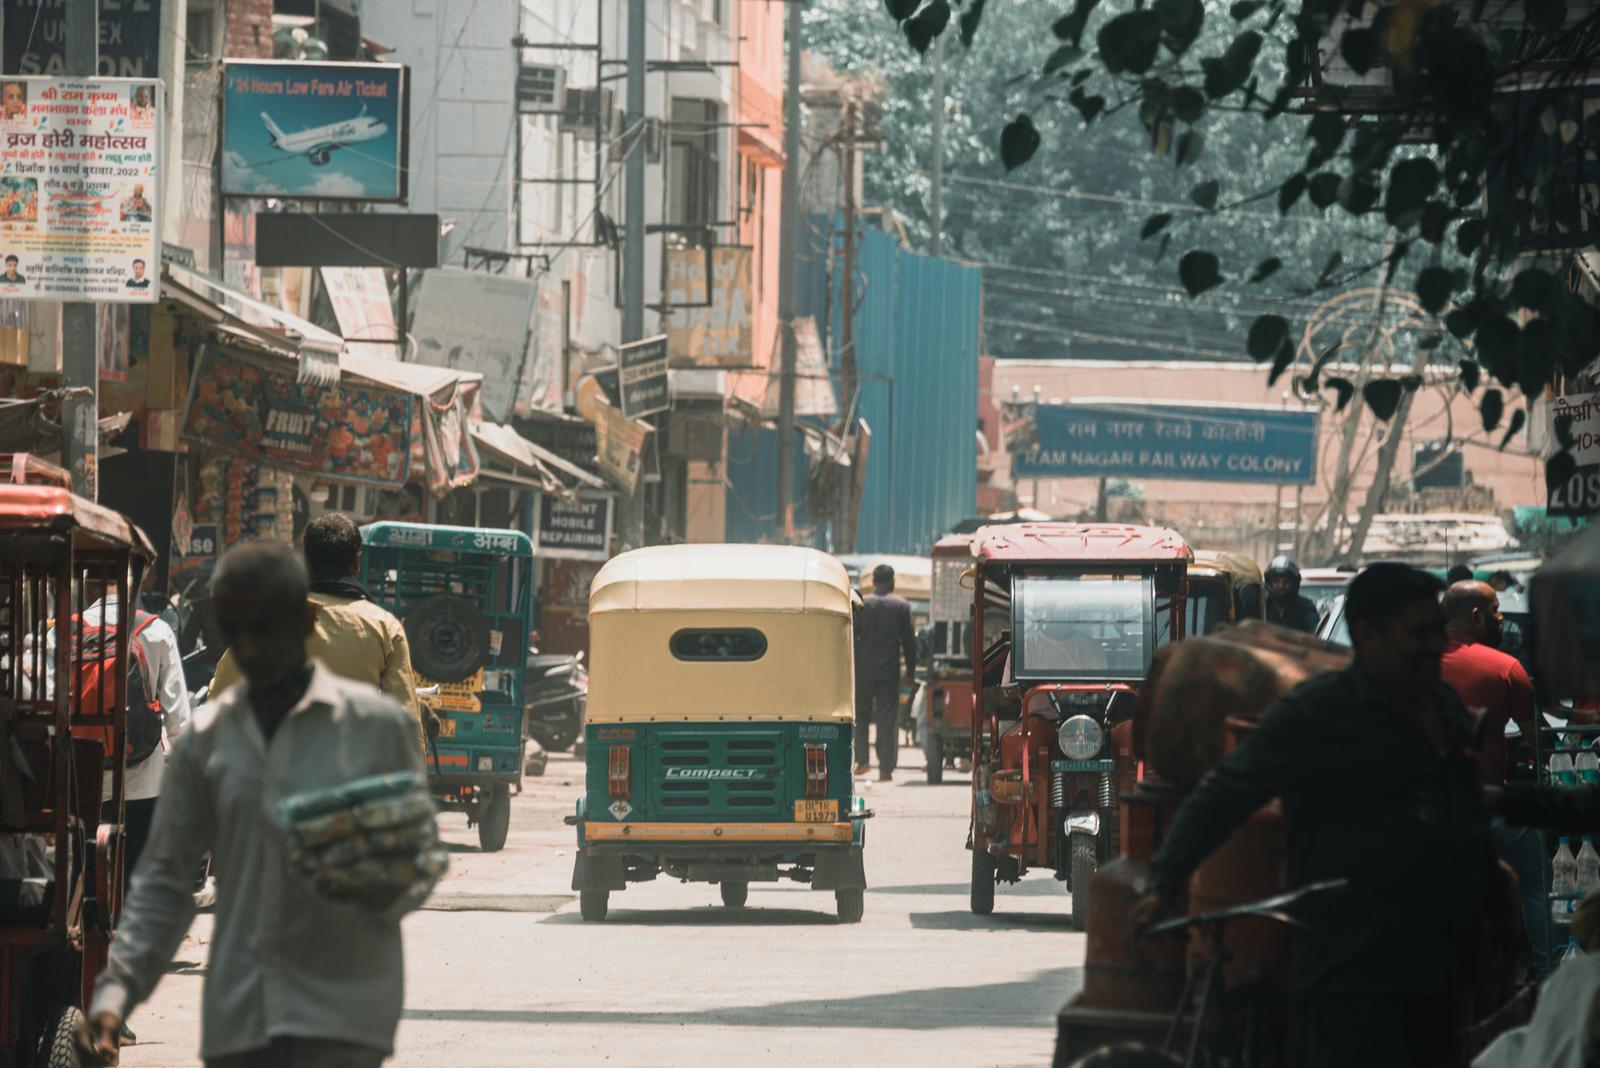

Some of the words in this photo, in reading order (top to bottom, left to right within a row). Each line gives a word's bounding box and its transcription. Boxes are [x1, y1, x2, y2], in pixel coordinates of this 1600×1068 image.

[20, 51, 144, 77] SAON
[41, 87, 57, 101] श्री
[61, 90, 83, 101] राम
[88, 92, 118, 105] कृष्ण
[251, 79, 283, 94] Hours
[286, 80, 309, 95] Low
[337, 80, 352, 96] Air
[356, 80, 387, 97] Ticket
[82, 105, 106, 116] कला
[7, 132, 36, 149] व्रज
[42, 129, 75, 148] होरी
[79, 131, 147, 151] महोत्सव
[670, 260, 737, 282] Hoel
[266, 409, 316, 436] FRUIT
[1067, 420, 1098, 438] राम
[1106, 420, 1145, 439] नगर
[1025, 450, 1067, 466] RAM
[1071, 451, 1135, 467] NAGAR
[1139, 451, 1222, 469] RAILWAY
[1226, 453, 1303, 474] COLONY
[550, 516, 595, 530] MOBILE
[540, 530, 604, 546] REPAIRING
